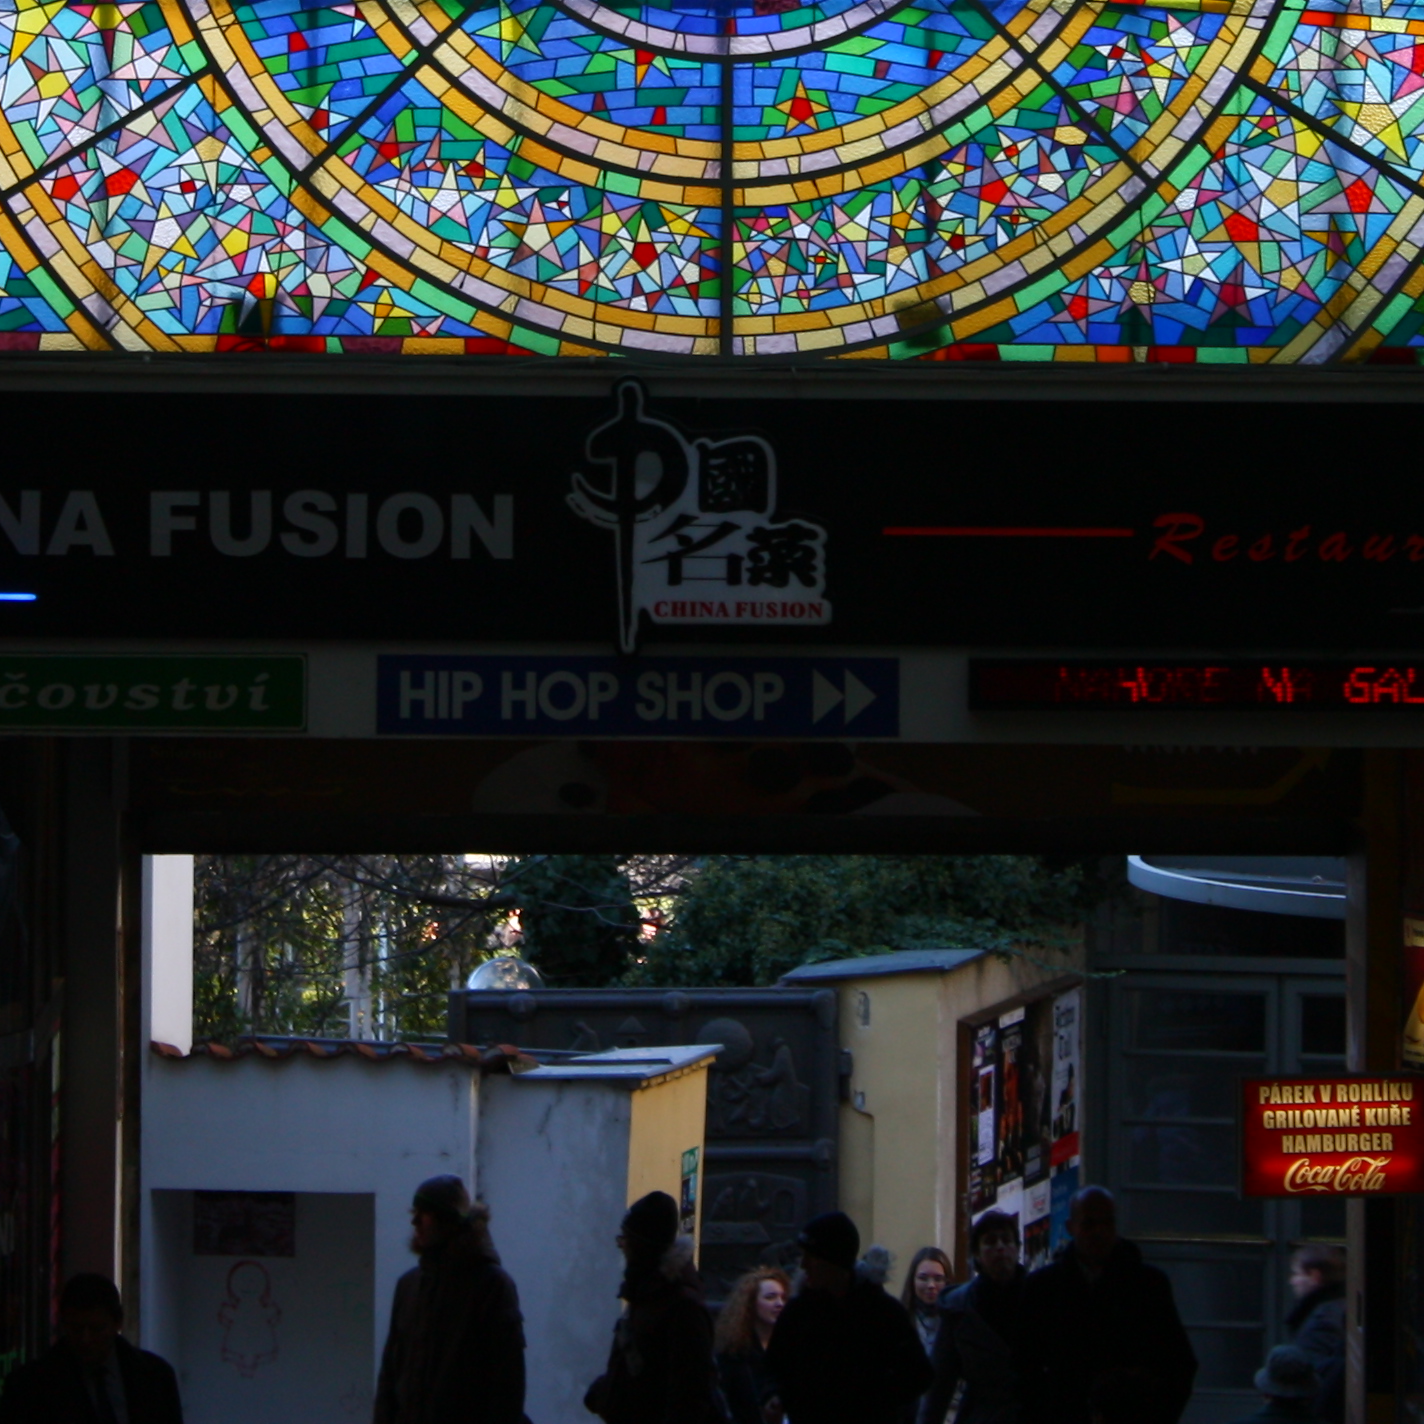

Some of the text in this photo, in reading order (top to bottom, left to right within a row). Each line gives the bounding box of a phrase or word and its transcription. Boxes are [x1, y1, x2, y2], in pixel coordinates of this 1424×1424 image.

[148, 488, 516, 561] FUSION
[653, 599, 825, 619] CHINA FUSION
[398, 669, 786, 722] HIP HOP SHOP
[1258, 1079, 1414, 1105] PÁREK V ROHLÍKU
[1262, 1103, 1413, 1130] GRILOVANÉ KUŘE
[1280, 1132, 1395, 1155] HAMBURGER
[1282, 1155, 1393, 1193] Coca-Cola
